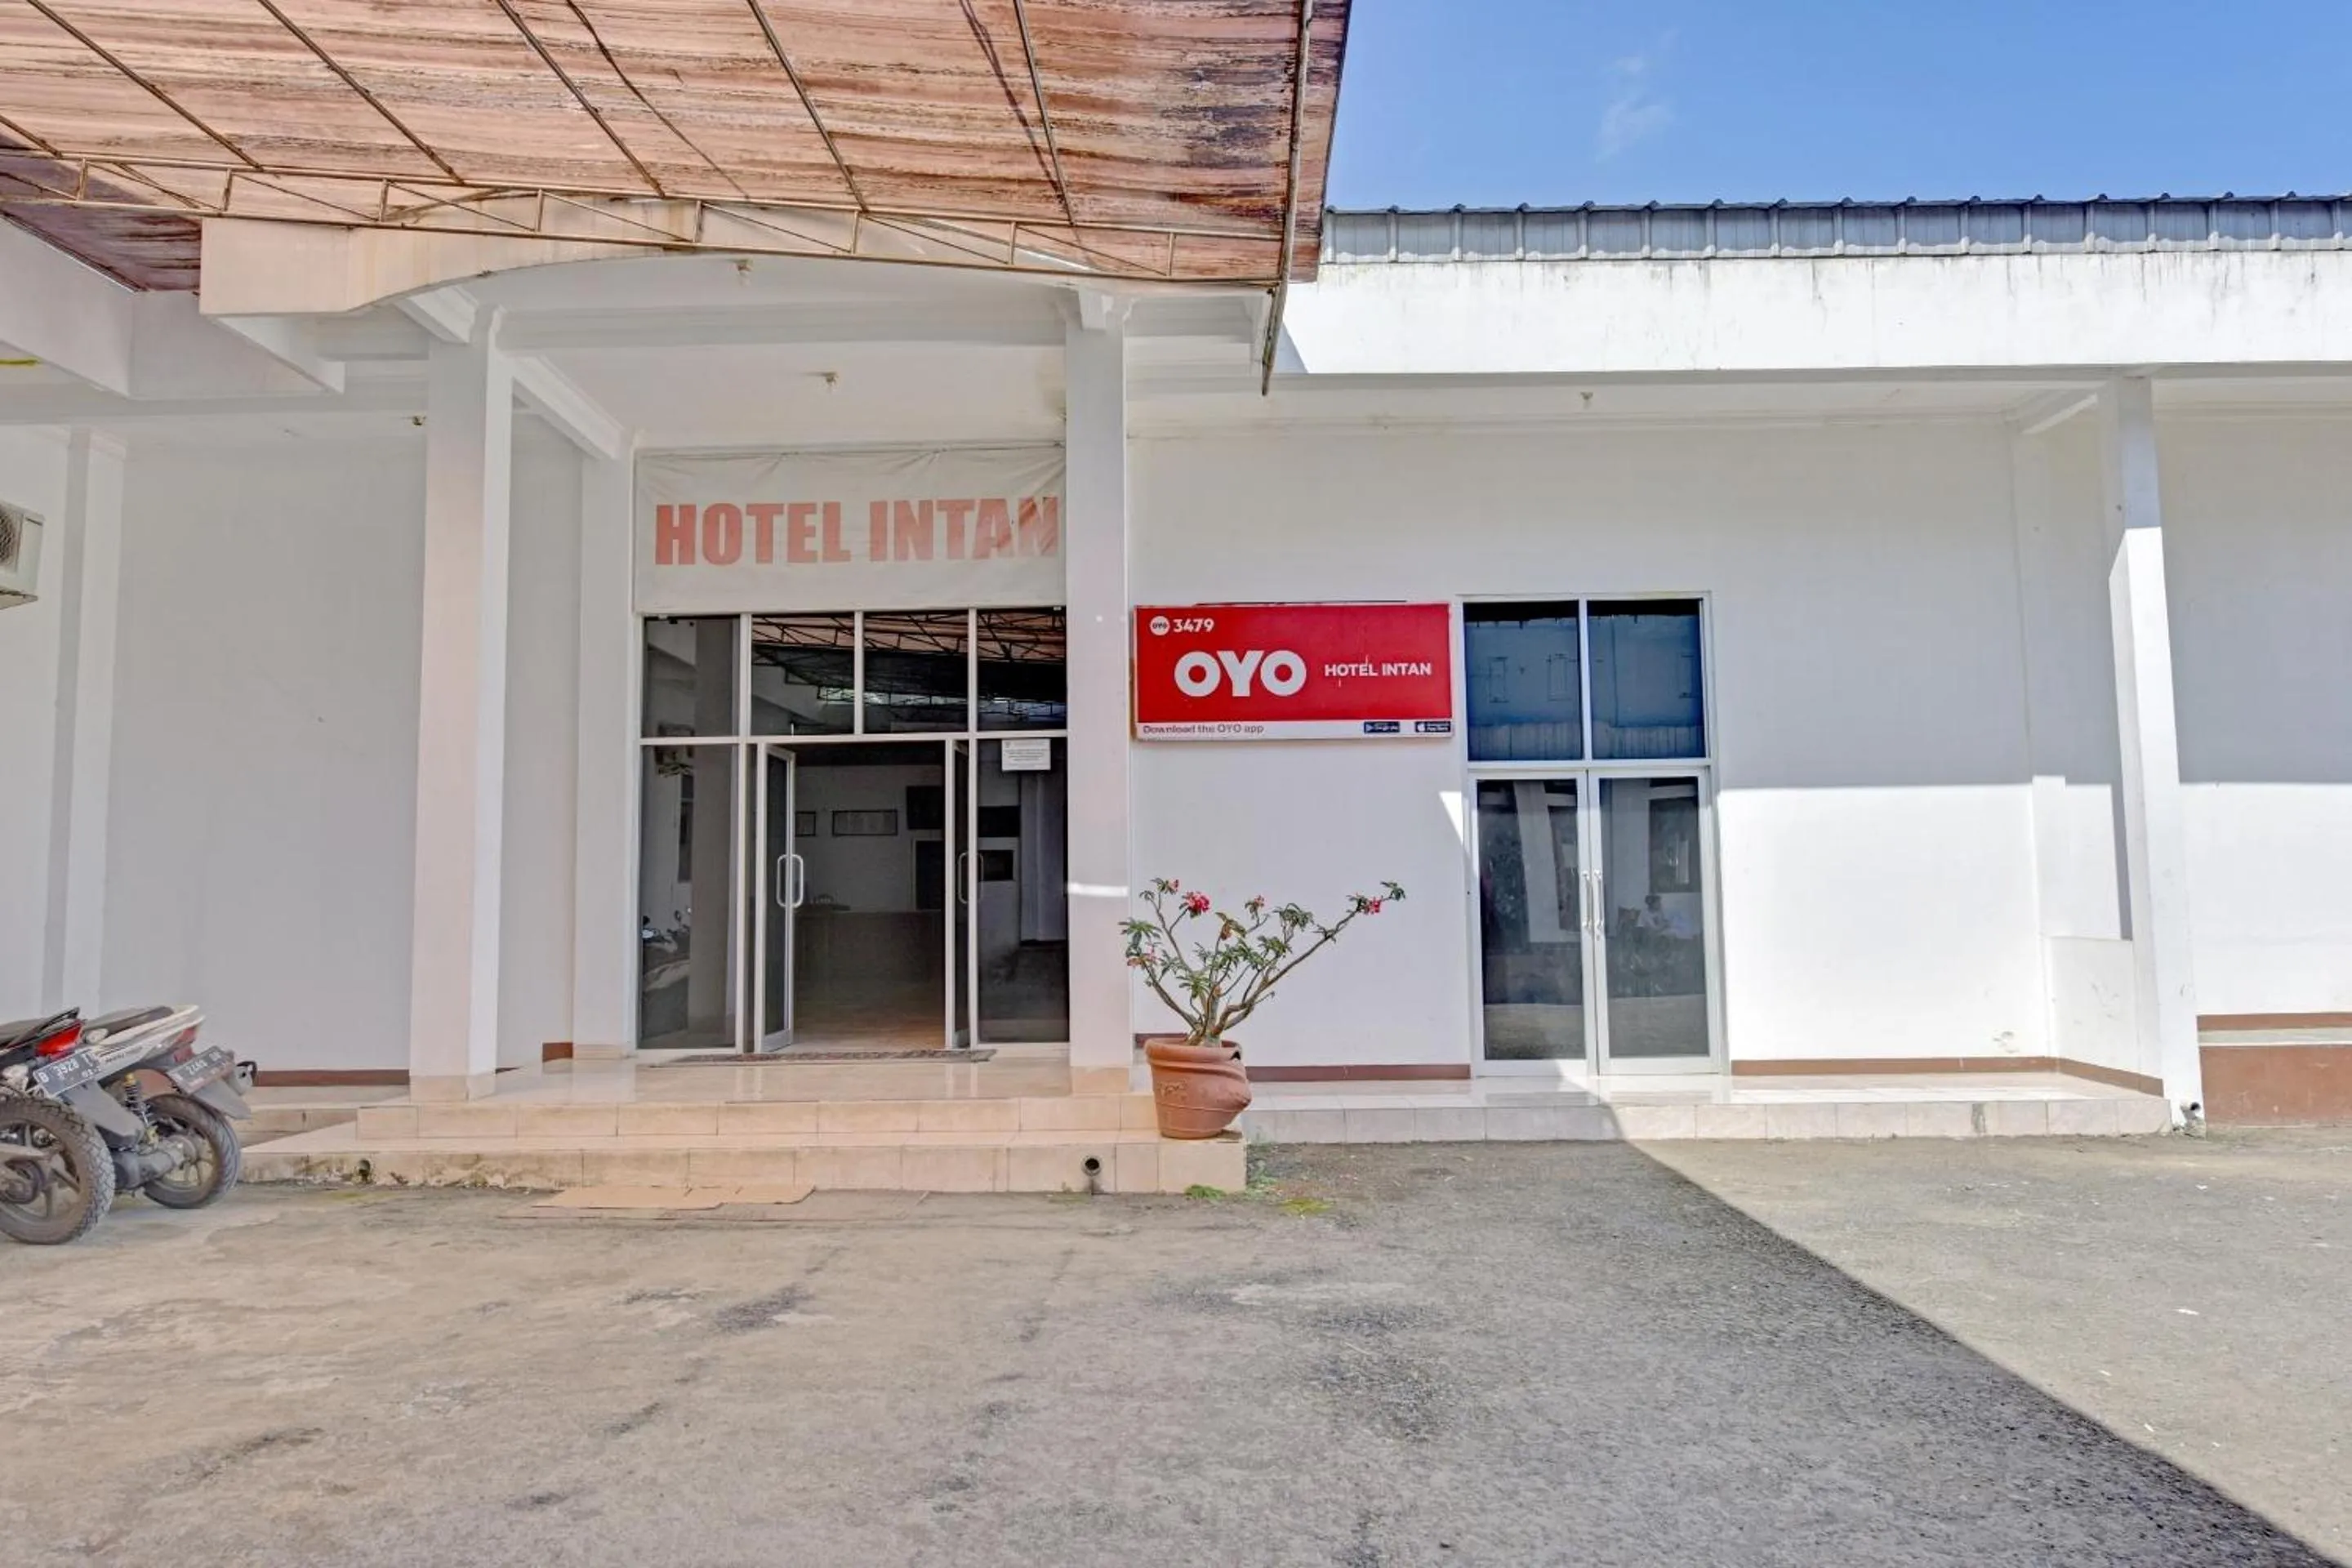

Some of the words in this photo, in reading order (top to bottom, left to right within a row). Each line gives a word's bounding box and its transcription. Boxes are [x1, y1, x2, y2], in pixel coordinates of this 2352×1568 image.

[654, 501, 851, 565] HOTEL
[869, 497, 1058, 562] INTAN
[1173, 618, 1214, 632] 3479
[1174, 650, 1307, 697] OYO
[1324, 664, 1379, 677] HOTEL
[1382, 662, 1432, 675] INTAN
[1143, 725, 1196, 733] Download
[1198, 724, 1214, 733] the
[1217, 724, 1242, 733] OYO
[1245, 725, 1265, 734] app
